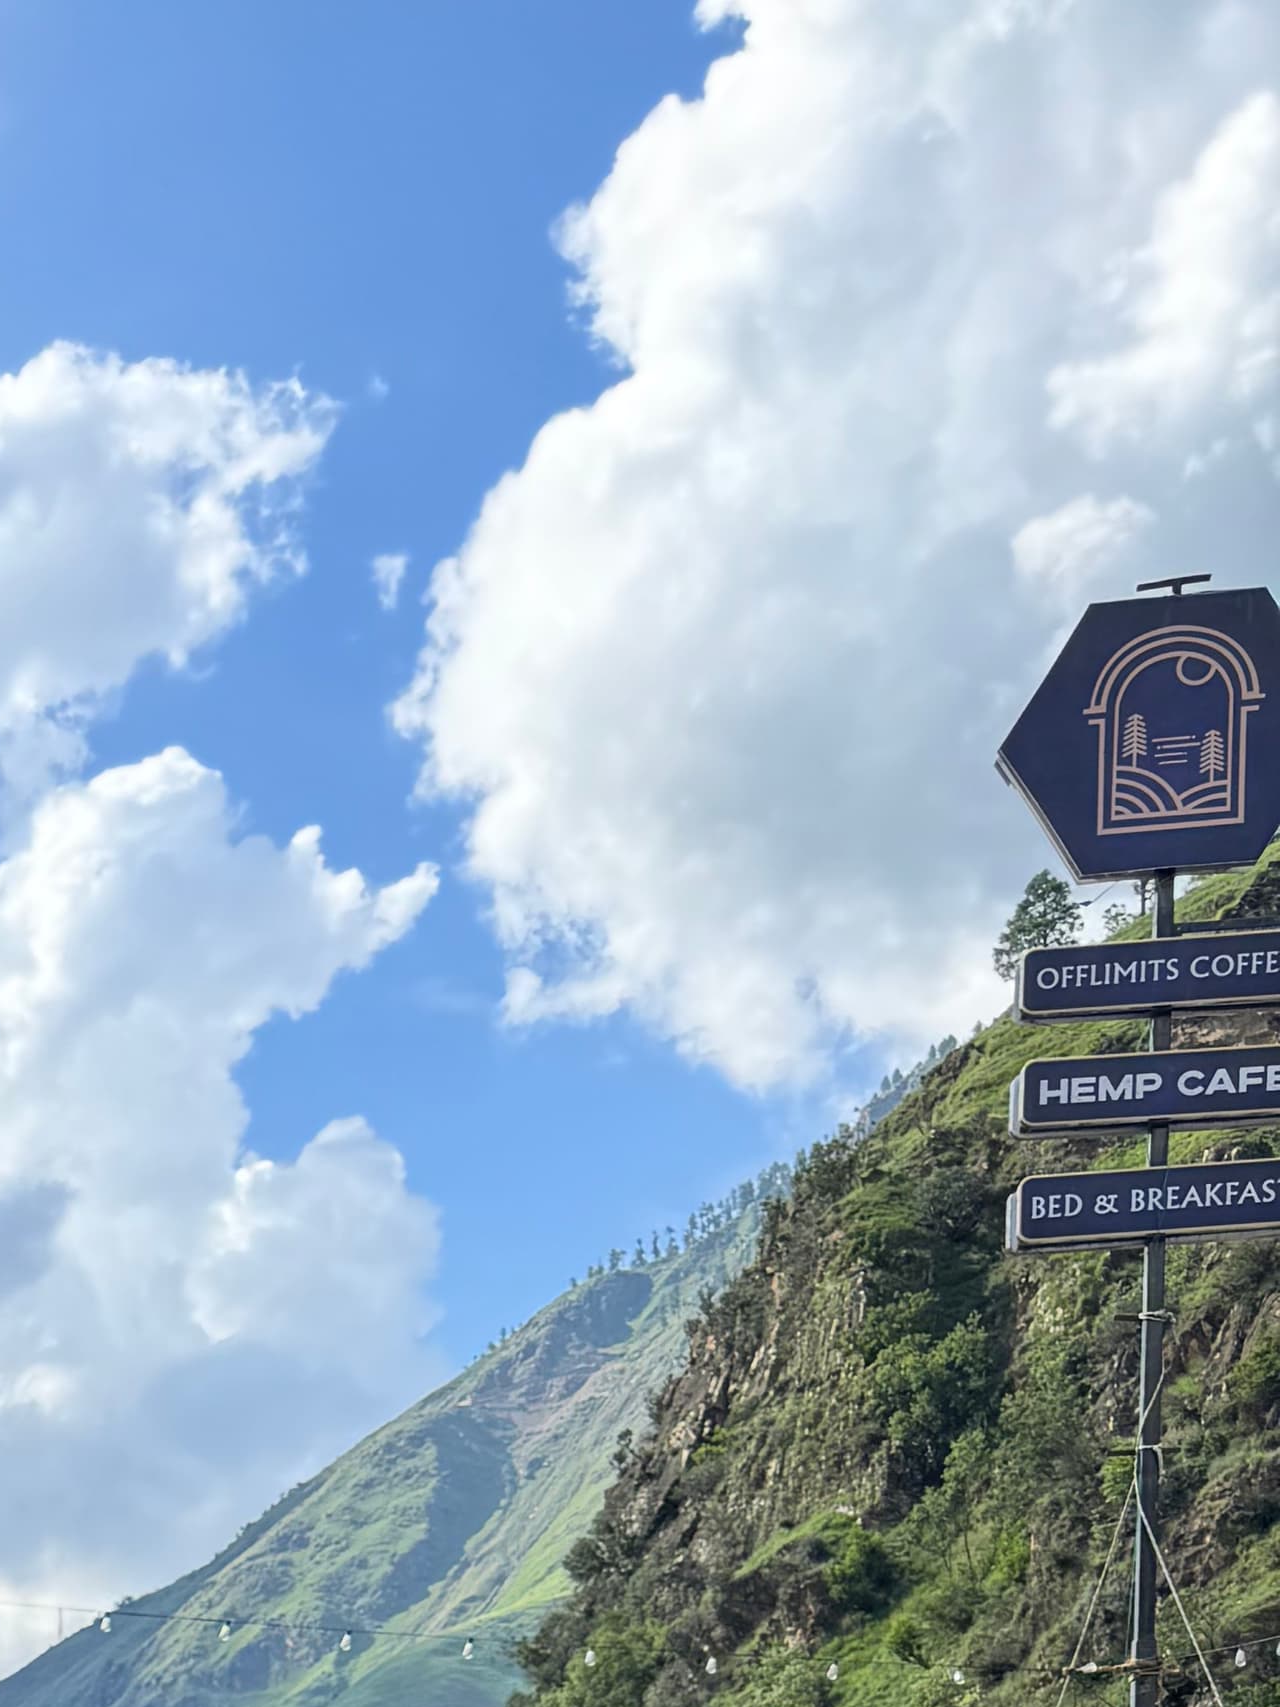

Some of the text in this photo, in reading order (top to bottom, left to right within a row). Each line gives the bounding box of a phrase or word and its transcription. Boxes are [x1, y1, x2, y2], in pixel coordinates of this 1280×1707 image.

[1037, 958, 1179, 990] OFFLIMITS
[1039, 1064, 1280, 1105] HEMP CAFE
[1031, 1179, 1280, 1219] BED & BREAKFAS
